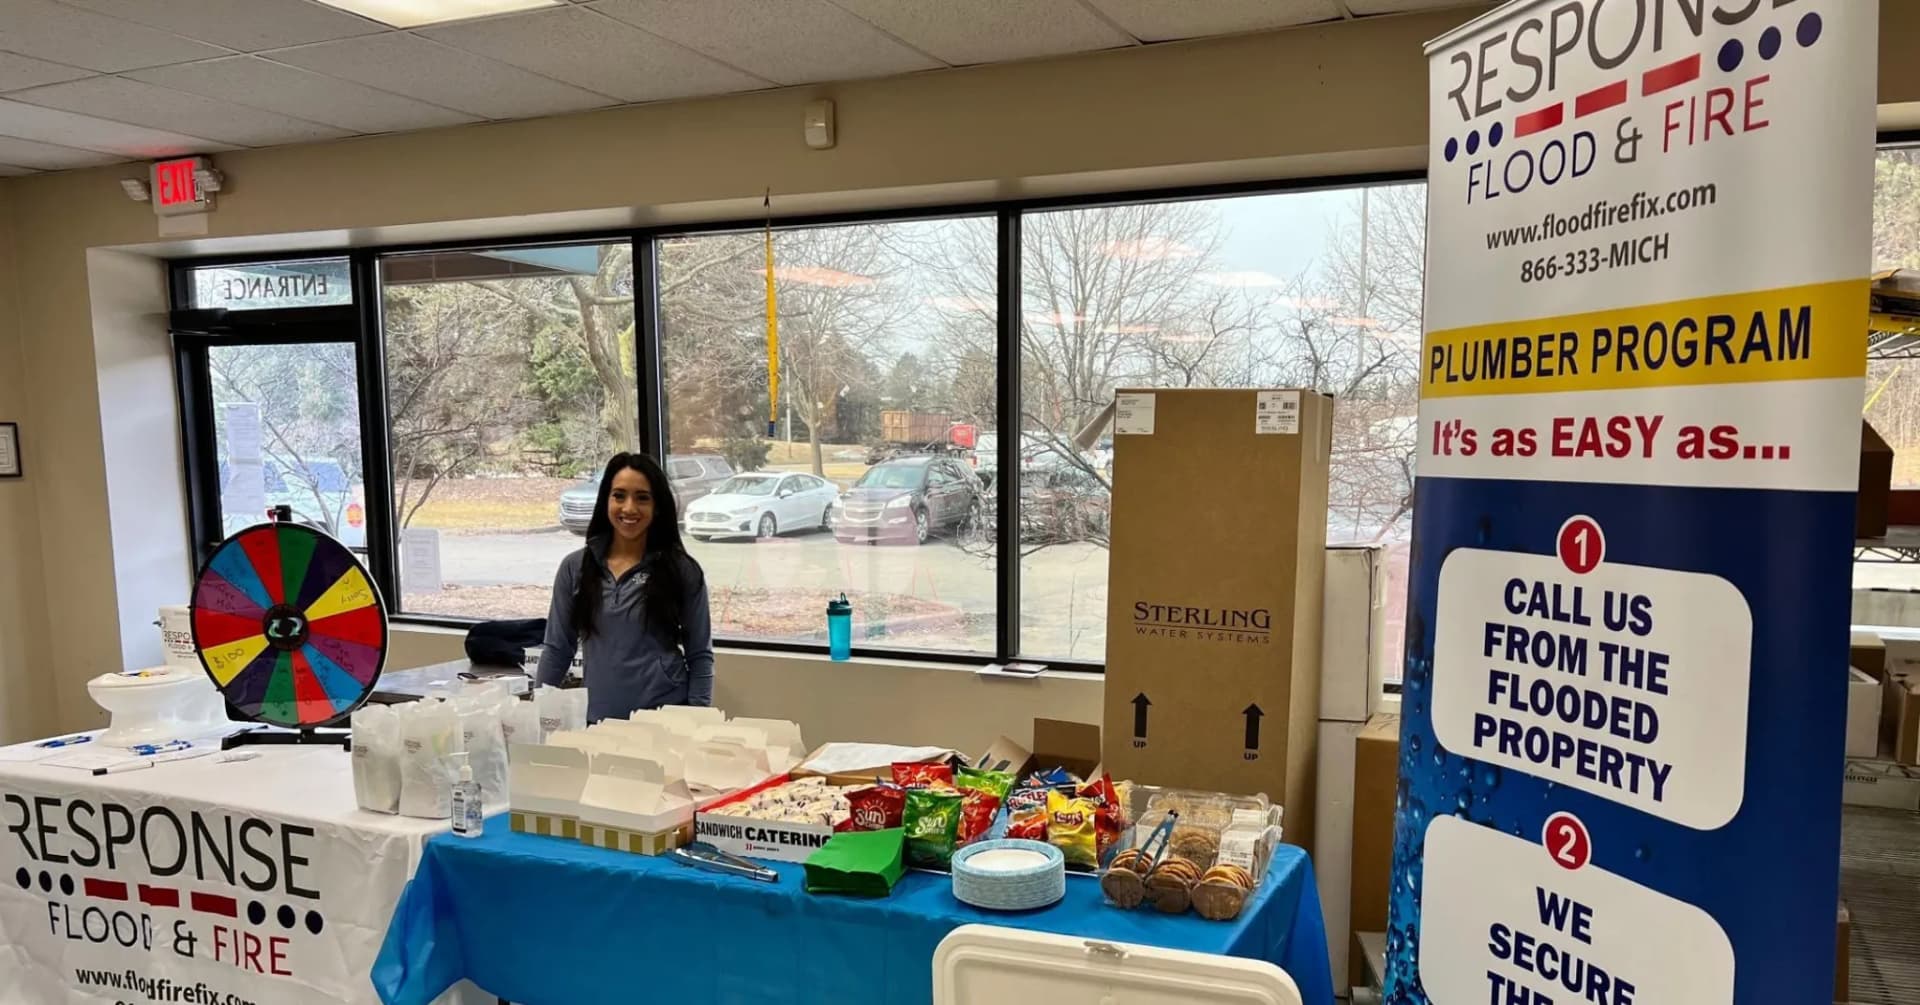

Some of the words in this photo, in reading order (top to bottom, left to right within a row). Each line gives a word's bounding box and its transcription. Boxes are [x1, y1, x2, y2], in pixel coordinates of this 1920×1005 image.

[1448, 0, 1797, 121] RESPON
[1467, 131, 1596, 204] FLOOD
[1614, 116, 1642, 164] &
[1664, 74, 1770, 153] FIRE
[156, 158, 196, 206] EXIT
[1486, 183, 1716, 250] www.floodfirefix.com
[1521, 233, 1669, 283] 866-333-MICH
[1430, 332, 1579, 384] PLUMBER
[1591, 305, 1812, 373] PROGRAM
[1432, 419, 1478, 456] It's
[1491, 426, 1537, 456] as
[1551, 415, 1664, 458] EASY
[1677, 423, 1790, 460] as...
[1574, 527, 1588, 567] 1
[1134, 601, 1271, 629] STERLING
[1504, 577, 1591, 626] CALL
[1604, 590, 1652, 636] US
[163, 630, 191, 640] RESPO
[213, 648, 244, 669] $100
[1136, 626, 1187, 639] WATER
[1197, 631, 1270, 645] SYSTEMS
[1484, 621, 1586, 676] FROM
[1599, 641, 1669, 696] THE
[1488, 669, 1660, 745] FLOODED
[1474, 712, 1672, 803] PROPERTY
[695, 821, 742, 839] SANDWICH
[855, 808, 886, 826] Sun
[915, 814, 947, 834] Sun
[1559, 823, 1578, 864] 2
[5, 793, 320, 900] RESPONSE
[1536, 886, 1593, 945] WE
[173, 920, 197, 958] &
[214, 924, 293, 976] FIRE
[1488, 922, 1635, 1005] SECURE
